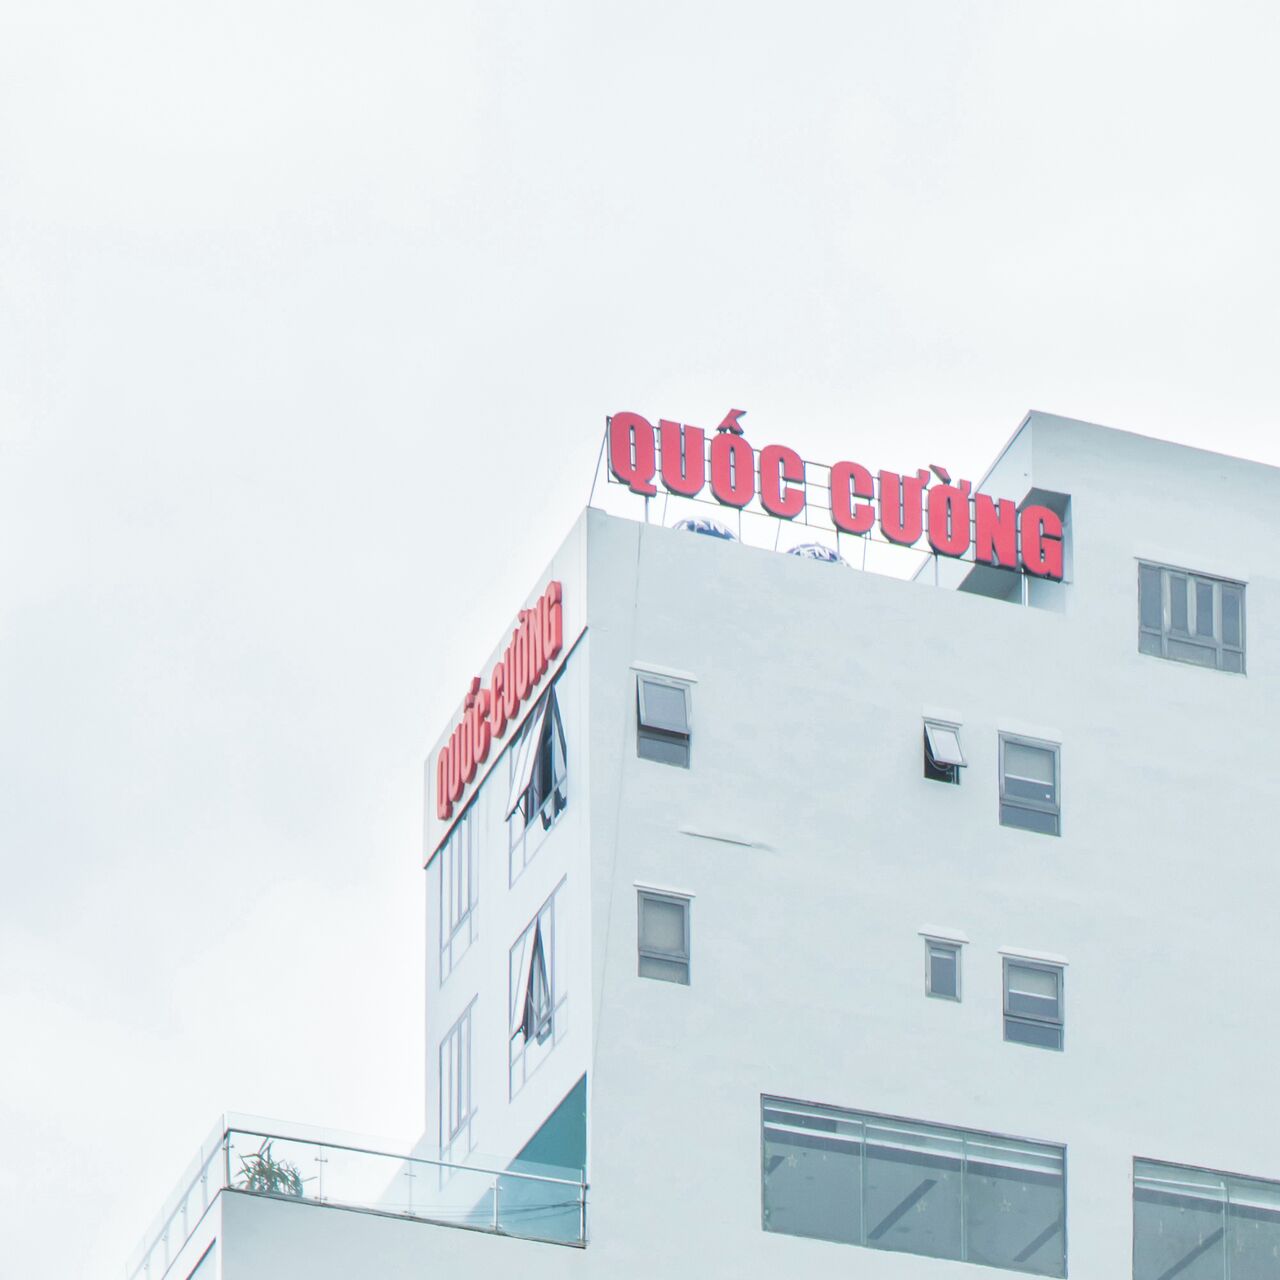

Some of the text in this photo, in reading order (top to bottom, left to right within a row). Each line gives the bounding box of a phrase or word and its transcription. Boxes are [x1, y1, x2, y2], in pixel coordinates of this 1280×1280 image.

[608, 408, 1064, 583] QUỐC CƯỜNG
[437, 580, 563, 821] QUỐC CƯỜNG
